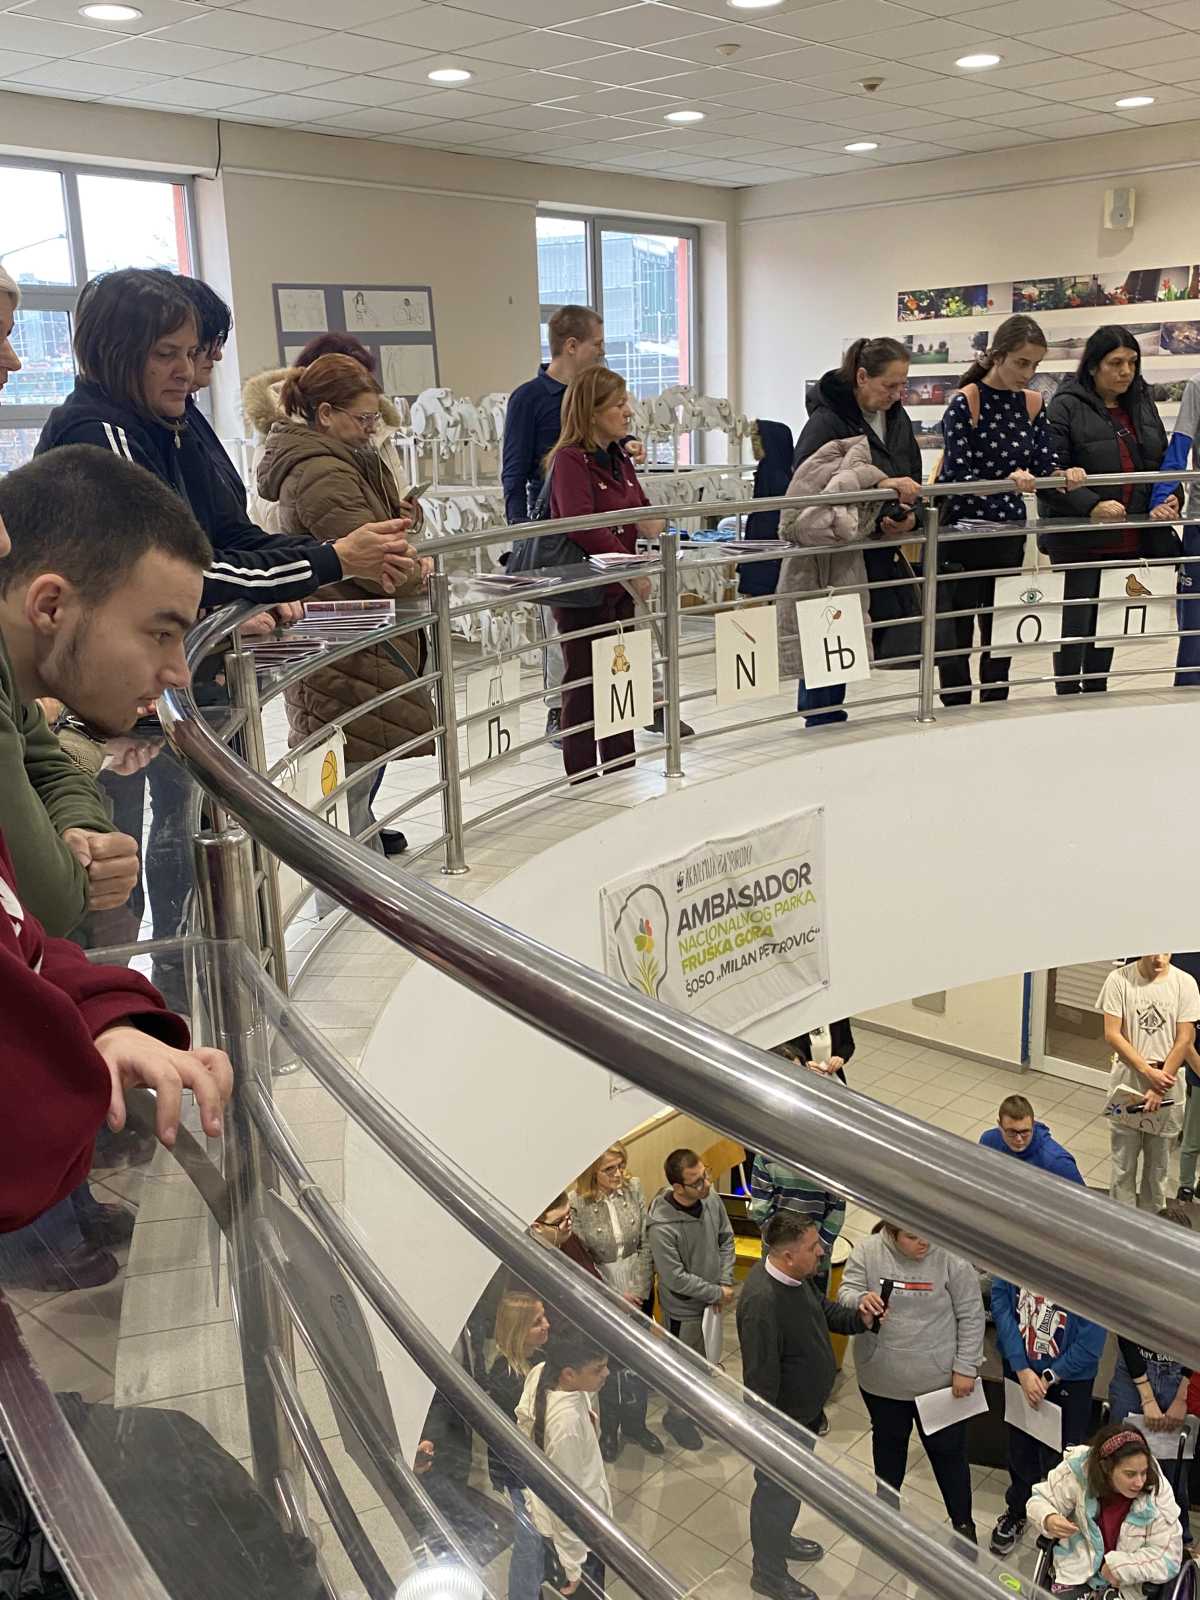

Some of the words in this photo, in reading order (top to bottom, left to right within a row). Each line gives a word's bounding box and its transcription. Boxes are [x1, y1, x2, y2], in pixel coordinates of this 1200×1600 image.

[823, 634, 856, 673] Њ
[677, 862, 812, 936] AMBASADOR
[678, 907, 772, 957] NACIONALNOG
[774, 889, 817, 918] PARKA
[734, 925, 775, 949] GORA
[685, 969, 715, 998] ŠOSO
